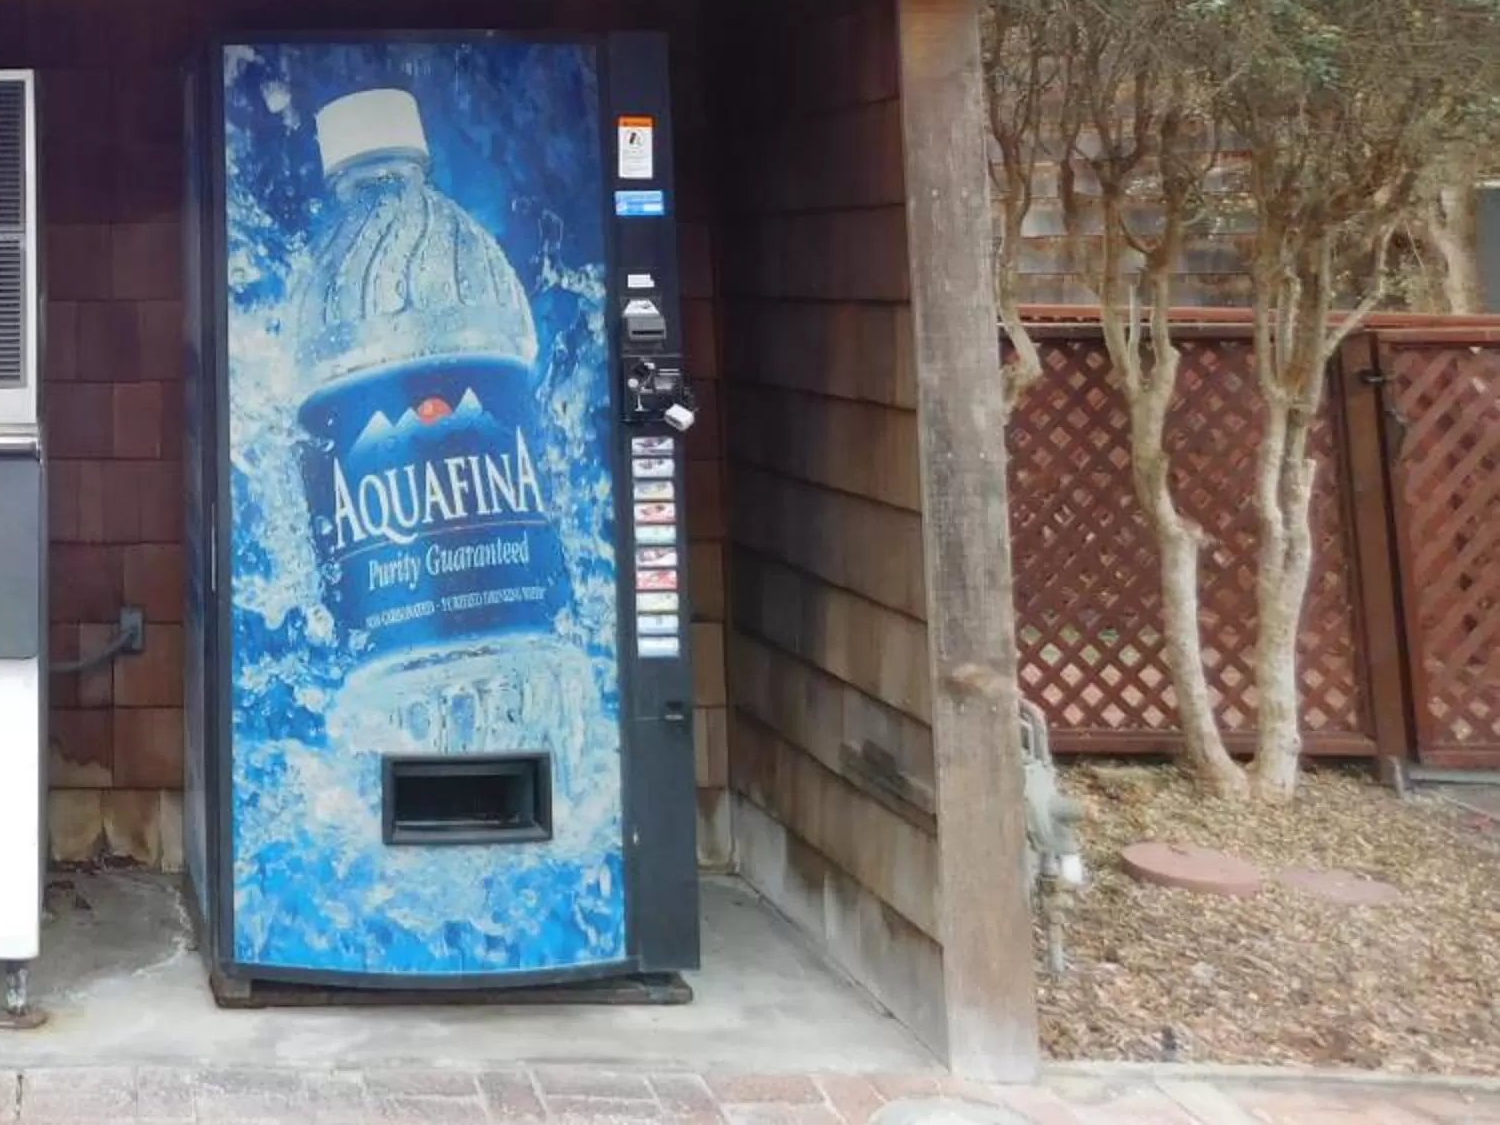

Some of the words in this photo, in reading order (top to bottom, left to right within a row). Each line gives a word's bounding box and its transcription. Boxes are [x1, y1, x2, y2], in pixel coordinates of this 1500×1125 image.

[334, 426, 545, 548] AQUAFINA
[368, 552, 421, 591] Purity
[426, 531, 530, 576] Guaranteed
